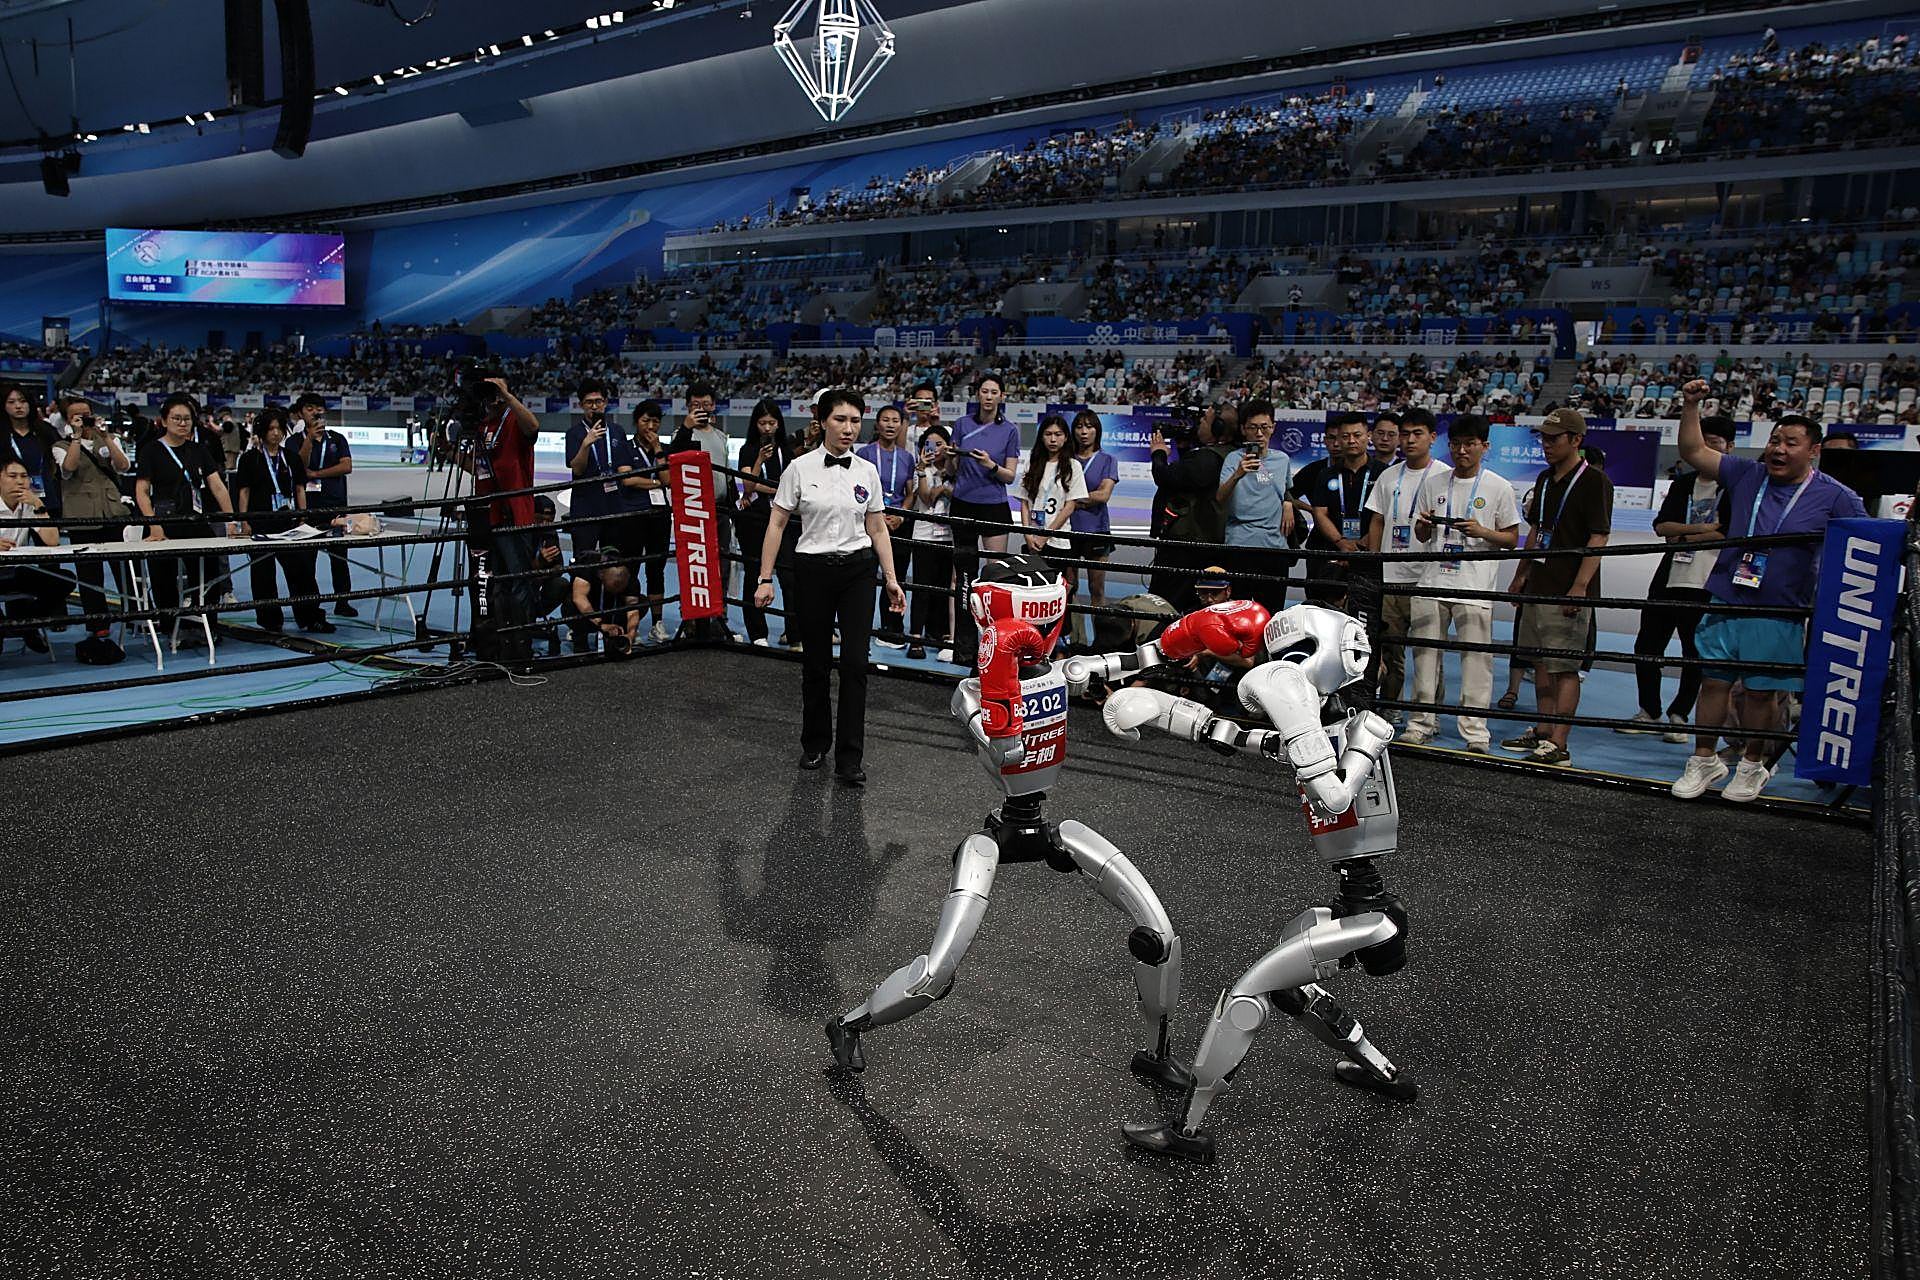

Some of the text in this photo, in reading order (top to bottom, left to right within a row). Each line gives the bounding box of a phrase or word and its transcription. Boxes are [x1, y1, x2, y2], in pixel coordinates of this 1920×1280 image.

[898, 330, 935, 347] 美团
[680, 464, 710, 608] UNITREE
[478, 556, 489, 616] UNITREE
[1021, 597, 1062, 618] FORCE
[1816, 536, 1882, 770] UNITREE
[1022, 726, 1065, 747] ITREE
